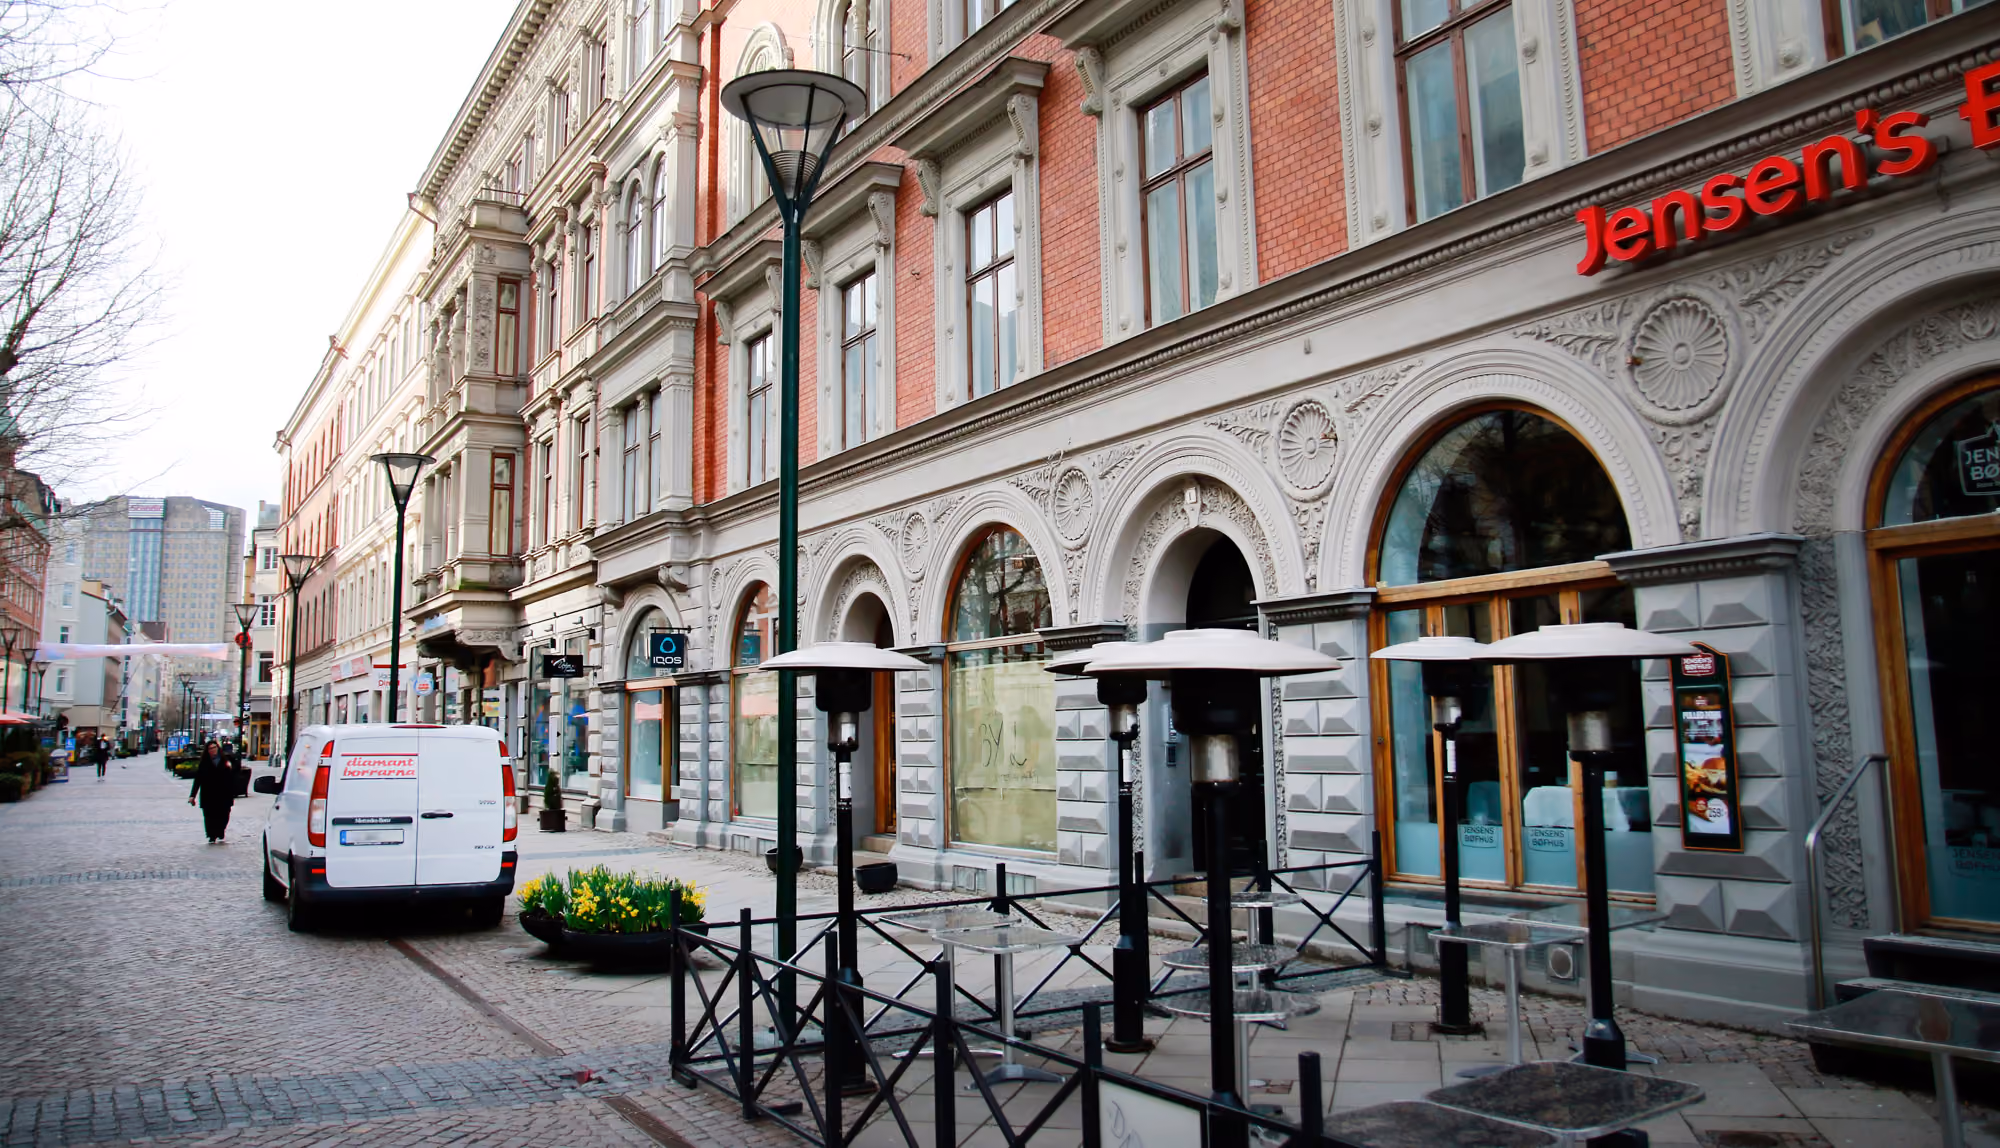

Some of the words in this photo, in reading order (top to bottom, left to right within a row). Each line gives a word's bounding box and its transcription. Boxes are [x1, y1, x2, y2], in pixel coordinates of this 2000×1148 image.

[1576, 108, 1938, 277] Jensen's
[653, 656, 682, 665] IQOS
[346, 757, 414, 767] diamant
[342, 767, 415, 777] borrarna
